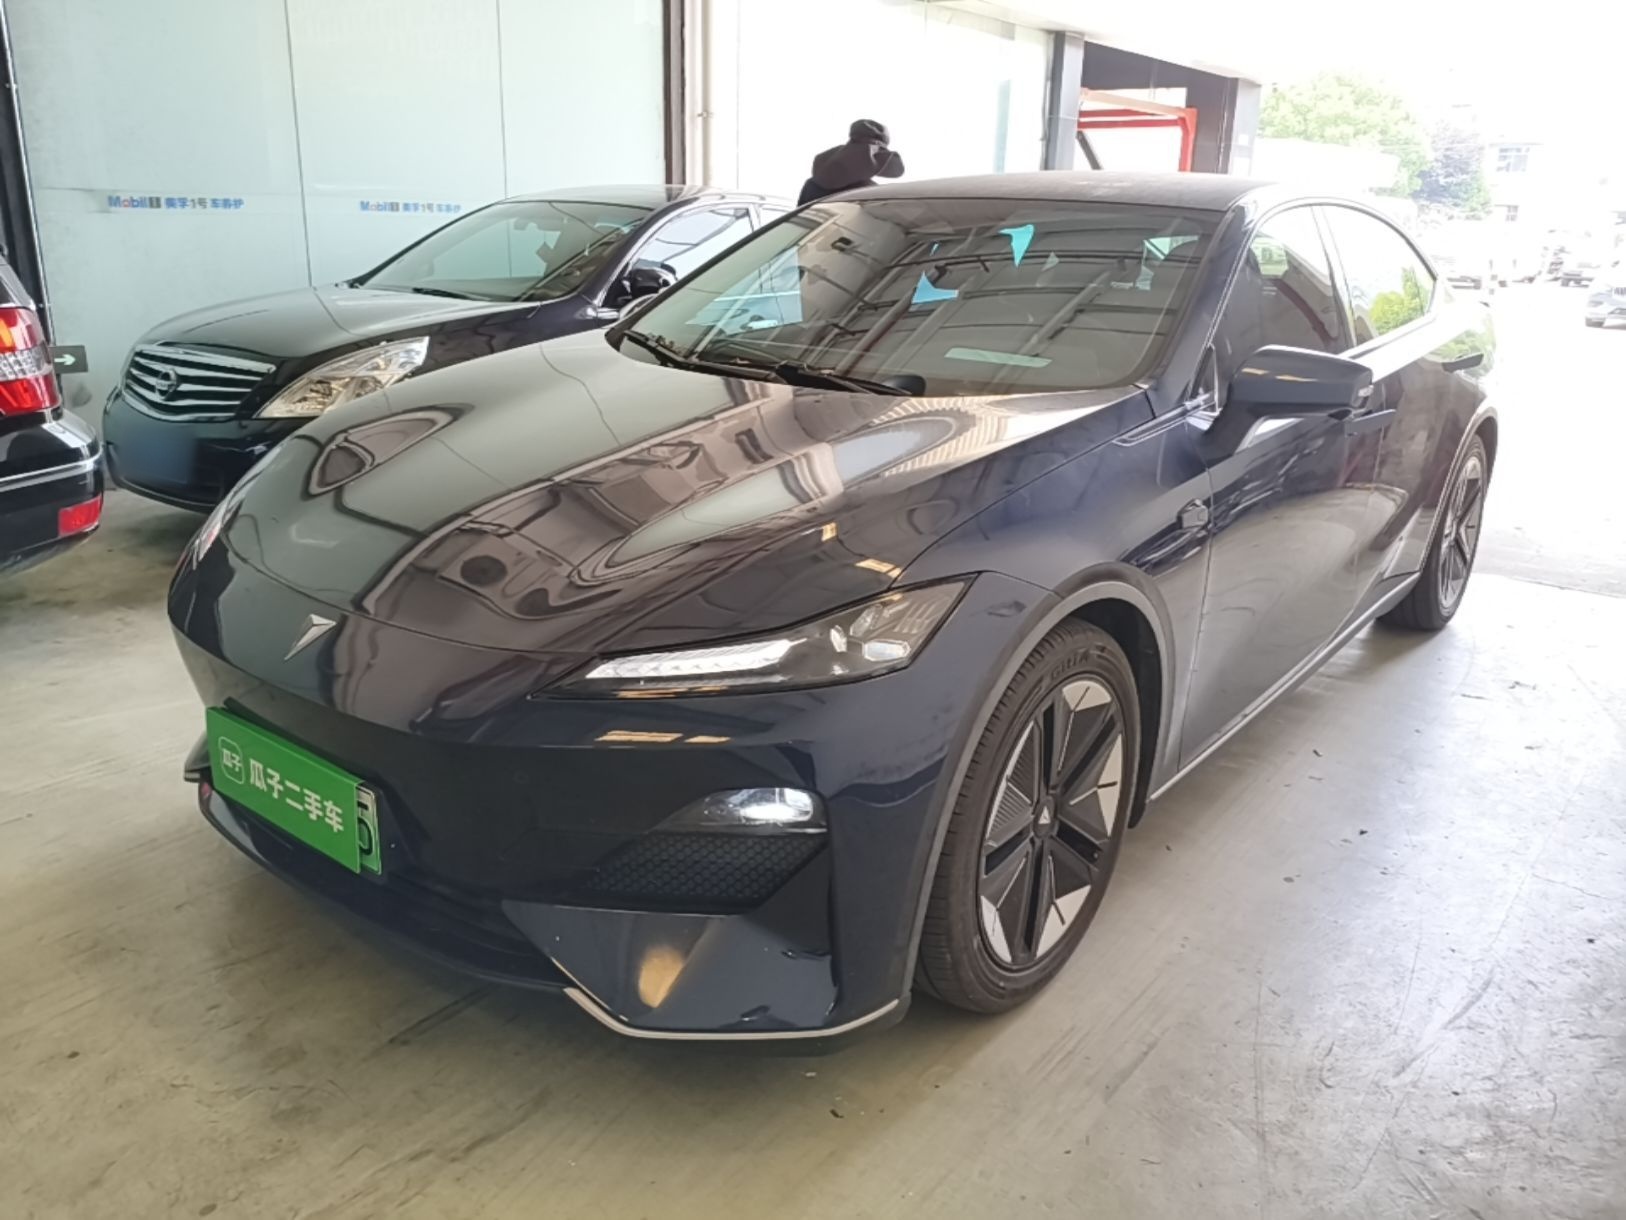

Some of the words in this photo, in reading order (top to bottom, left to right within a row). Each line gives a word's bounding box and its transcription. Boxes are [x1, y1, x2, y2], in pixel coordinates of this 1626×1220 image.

[249, 757, 345, 833] 瓜子二手车
